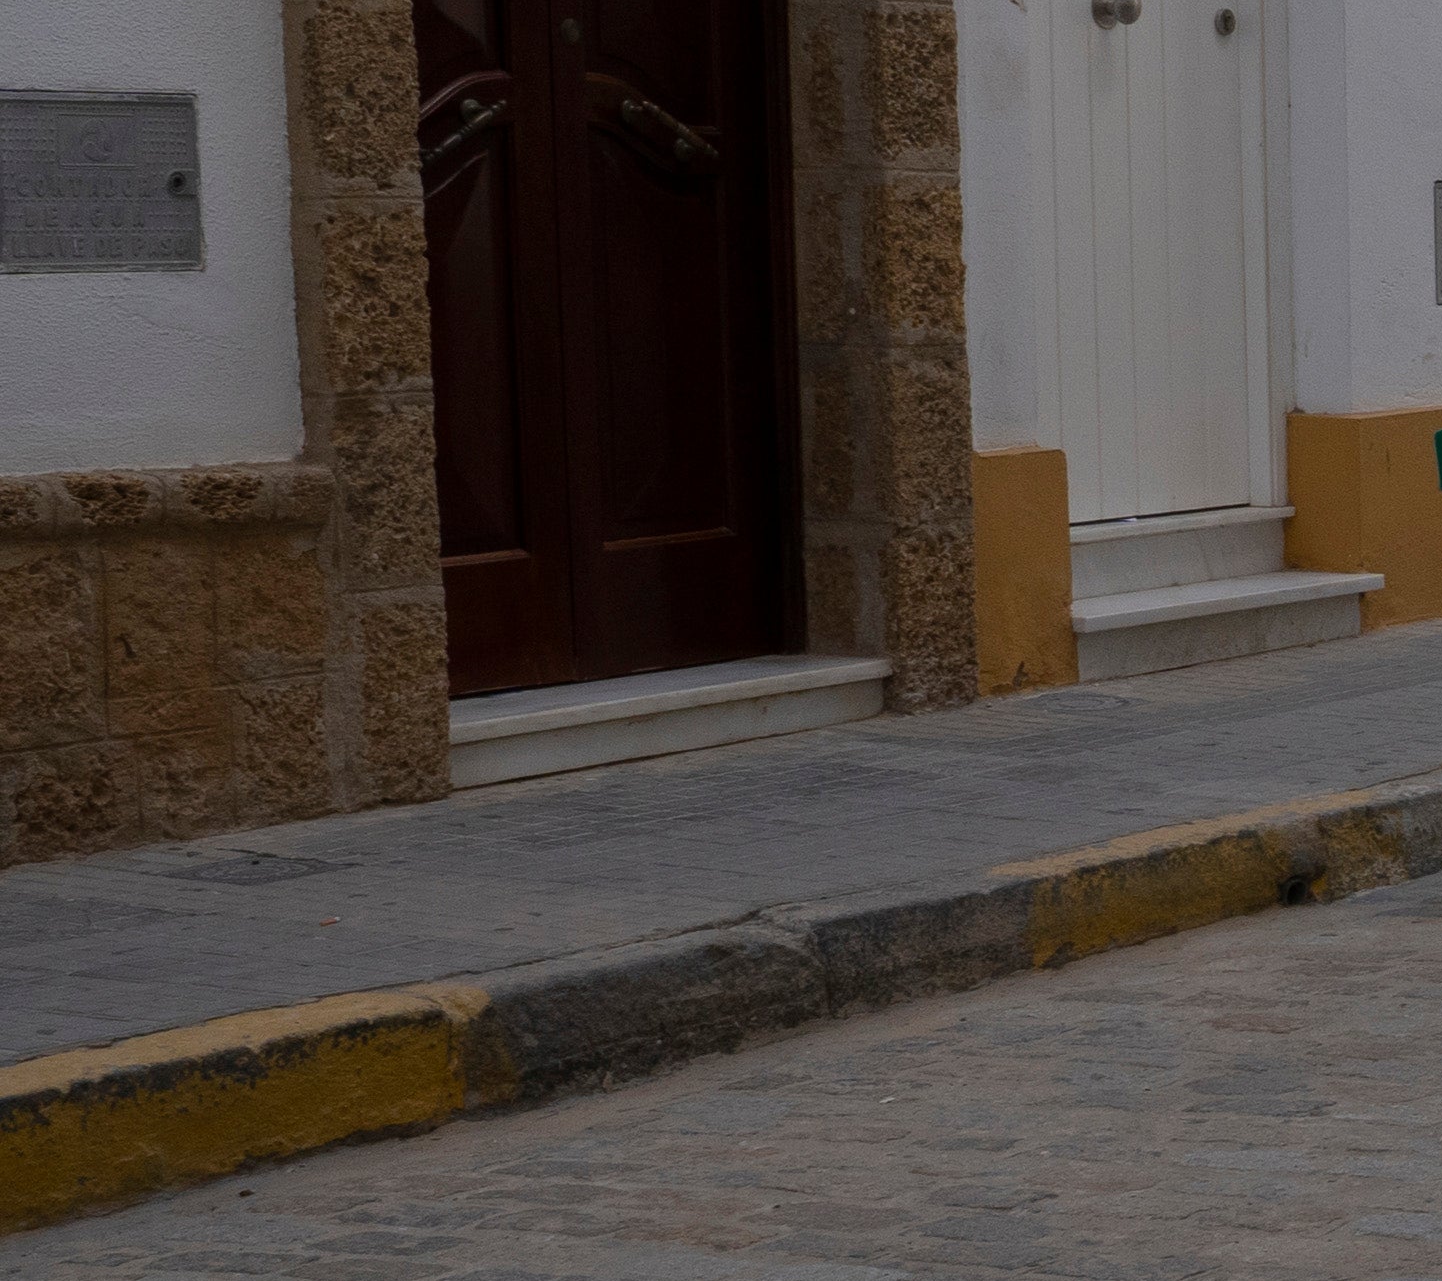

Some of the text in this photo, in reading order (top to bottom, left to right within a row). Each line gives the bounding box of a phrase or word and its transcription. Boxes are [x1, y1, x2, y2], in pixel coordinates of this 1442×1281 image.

[69, 205, 145, 228] AGUA
[12, 234, 85, 259] LLAVE
[95, 234, 124, 258] DE
